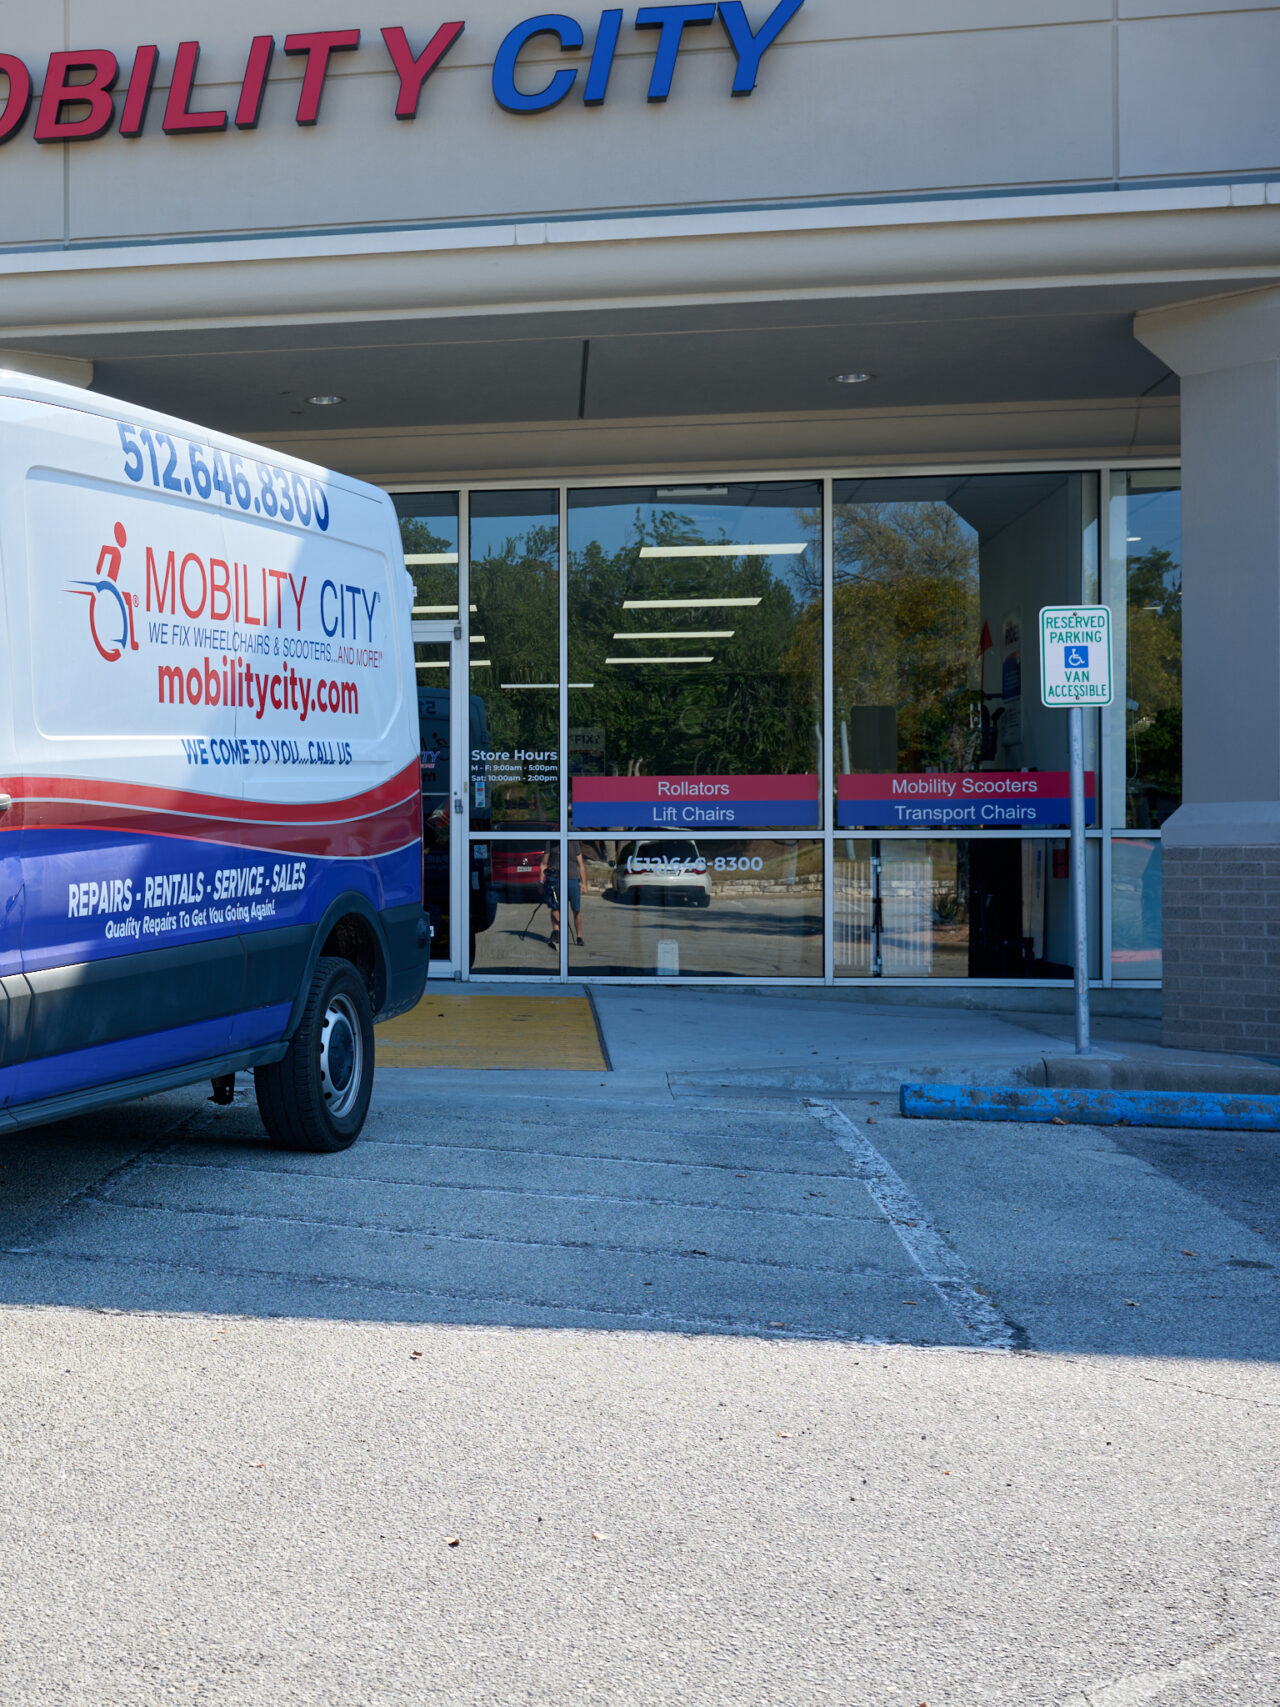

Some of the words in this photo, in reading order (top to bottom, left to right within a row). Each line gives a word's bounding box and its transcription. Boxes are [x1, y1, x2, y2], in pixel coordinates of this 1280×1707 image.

[492, 0, 804, 115] CITY
[117, 422, 329, 531] 512.646.8300
[145, 546, 307, 631] MOBILITY
[1045, 615, 1106, 629] RESERVED
[148, 622, 168, 644] WE
[172, 625, 190, 647] FIX
[193, 627, 270, 655] WHEELCHAIRS
[273, 637, 280, 656] &
[1049, 631, 1102, 644] PARKING
[1064, 671, 1090, 683] VAN
[158, 655, 359, 721] mobilitycity.com
[1047, 684, 1107, 698] ACCESSIBLE
[181, 739, 209, 765] WE
[210, 739, 250, 765] COME
[251, 739, 270, 764] TO
[337, 742, 352, 765] US
[471, 750, 510, 761] Store
[514, 749, 558, 761] Hours
[528, 775, 558, 783] 2:00pm
[657, 781, 730, 796] Rollators
[892, 779, 956, 797] Mobility
[962, 778, 1038, 793] Scooters
[652, 806, 682, 821] Lift
[684, 806, 735, 821] Chairs
[894, 805, 976, 823] Transport
[981, 804, 1036, 819] Chairs
[626, 856, 763, 874] (512)646-8300
[68, 879, 132, 918] REPAIRS
[144, 871, 204, 908] RENTALS
[213, 866, 264, 900] SERVICE
[271, 862, 306, 893] SALES
[105, 918, 141, 939] Quality
[143, 913, 177, 935] Repairs
[179, 911, 190, 928] To
[192, 908, 207, 926] Get
[209, 907, 224, 924] You
[225, 903, 249, 922] Going
[250, 900, 276, 920] Again!
